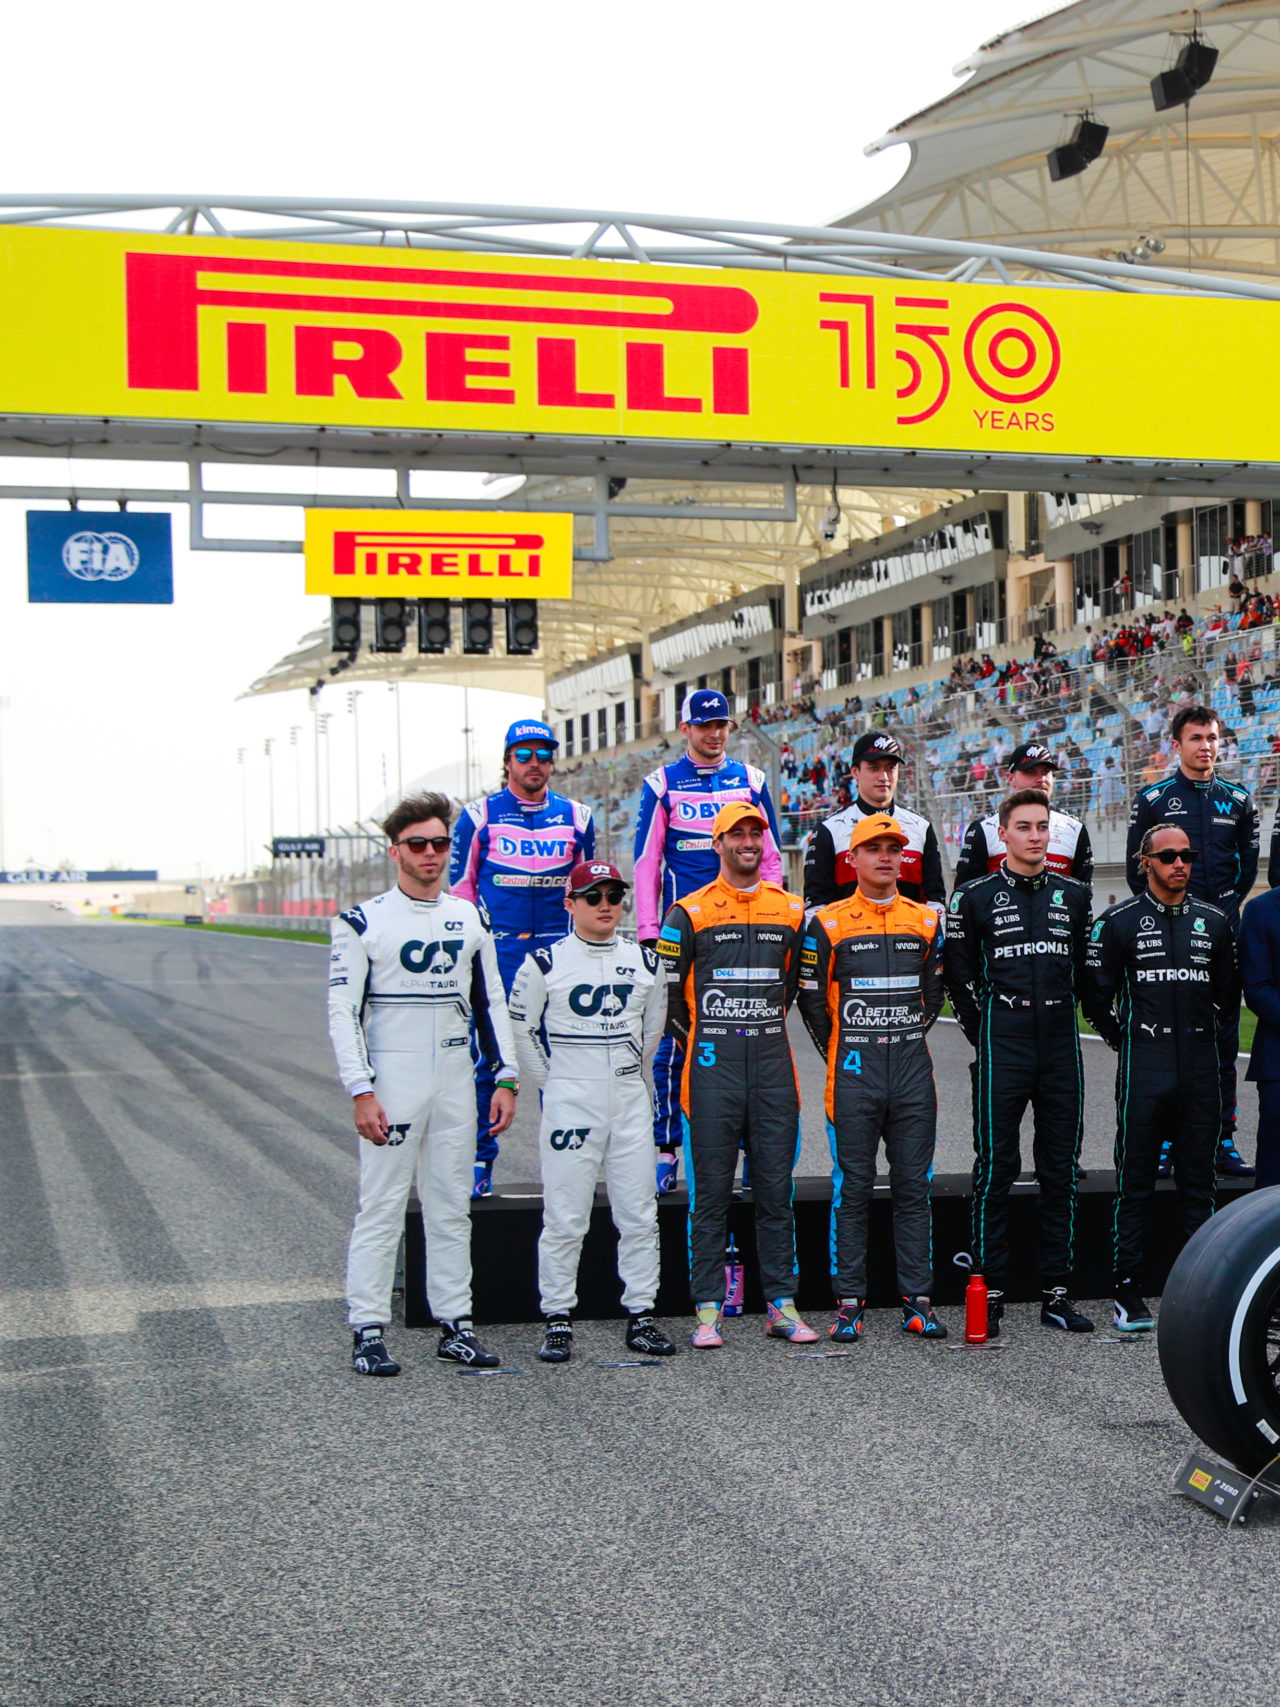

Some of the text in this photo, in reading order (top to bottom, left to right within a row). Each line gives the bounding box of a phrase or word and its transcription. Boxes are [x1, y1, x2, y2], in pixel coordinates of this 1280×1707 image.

[125, 252, 759, 416] PIRELLI
[819, 292, 1061, 425] 150
[973, 409, 1055, 432] YEARS
[69, 541, 132, 571] FIA
[332, 531, 545, 577] PIRELLI
[515, 725, 550, 737] kimoa
[519, 839, 569, 857] BWT
[685, 840, 711, 849] Castrol
[57, 872, 88, 882] AIR
[1003, 914, 1020, 923] UBS
[1048, 912, 1070, 922] INEOS
[851, 942, 879, 952] splunk>
[994, 941, 1069, 958] PETRONAS
[1146, 939, 1162, 948] UBS
[715, 969, 736, 977] DELL
[1136, 968, 1210, 982] PETRONAS
[854, 979, 877, 987] DELL
[712, 998, 767, 1008] A BETTER
[709, 1006, 779, 1018] TOMORROW
[854, 1006, 909, 1017] A BETTER
[851, 1013, 921, 1026] TOMORROW
[697, 1042, 716, 1067] 3
[843, 1050, 862, 1075] 4
[1214, 1479, 1222, 1487] P
[1219, 1482, 1239, 1497] ZERO
